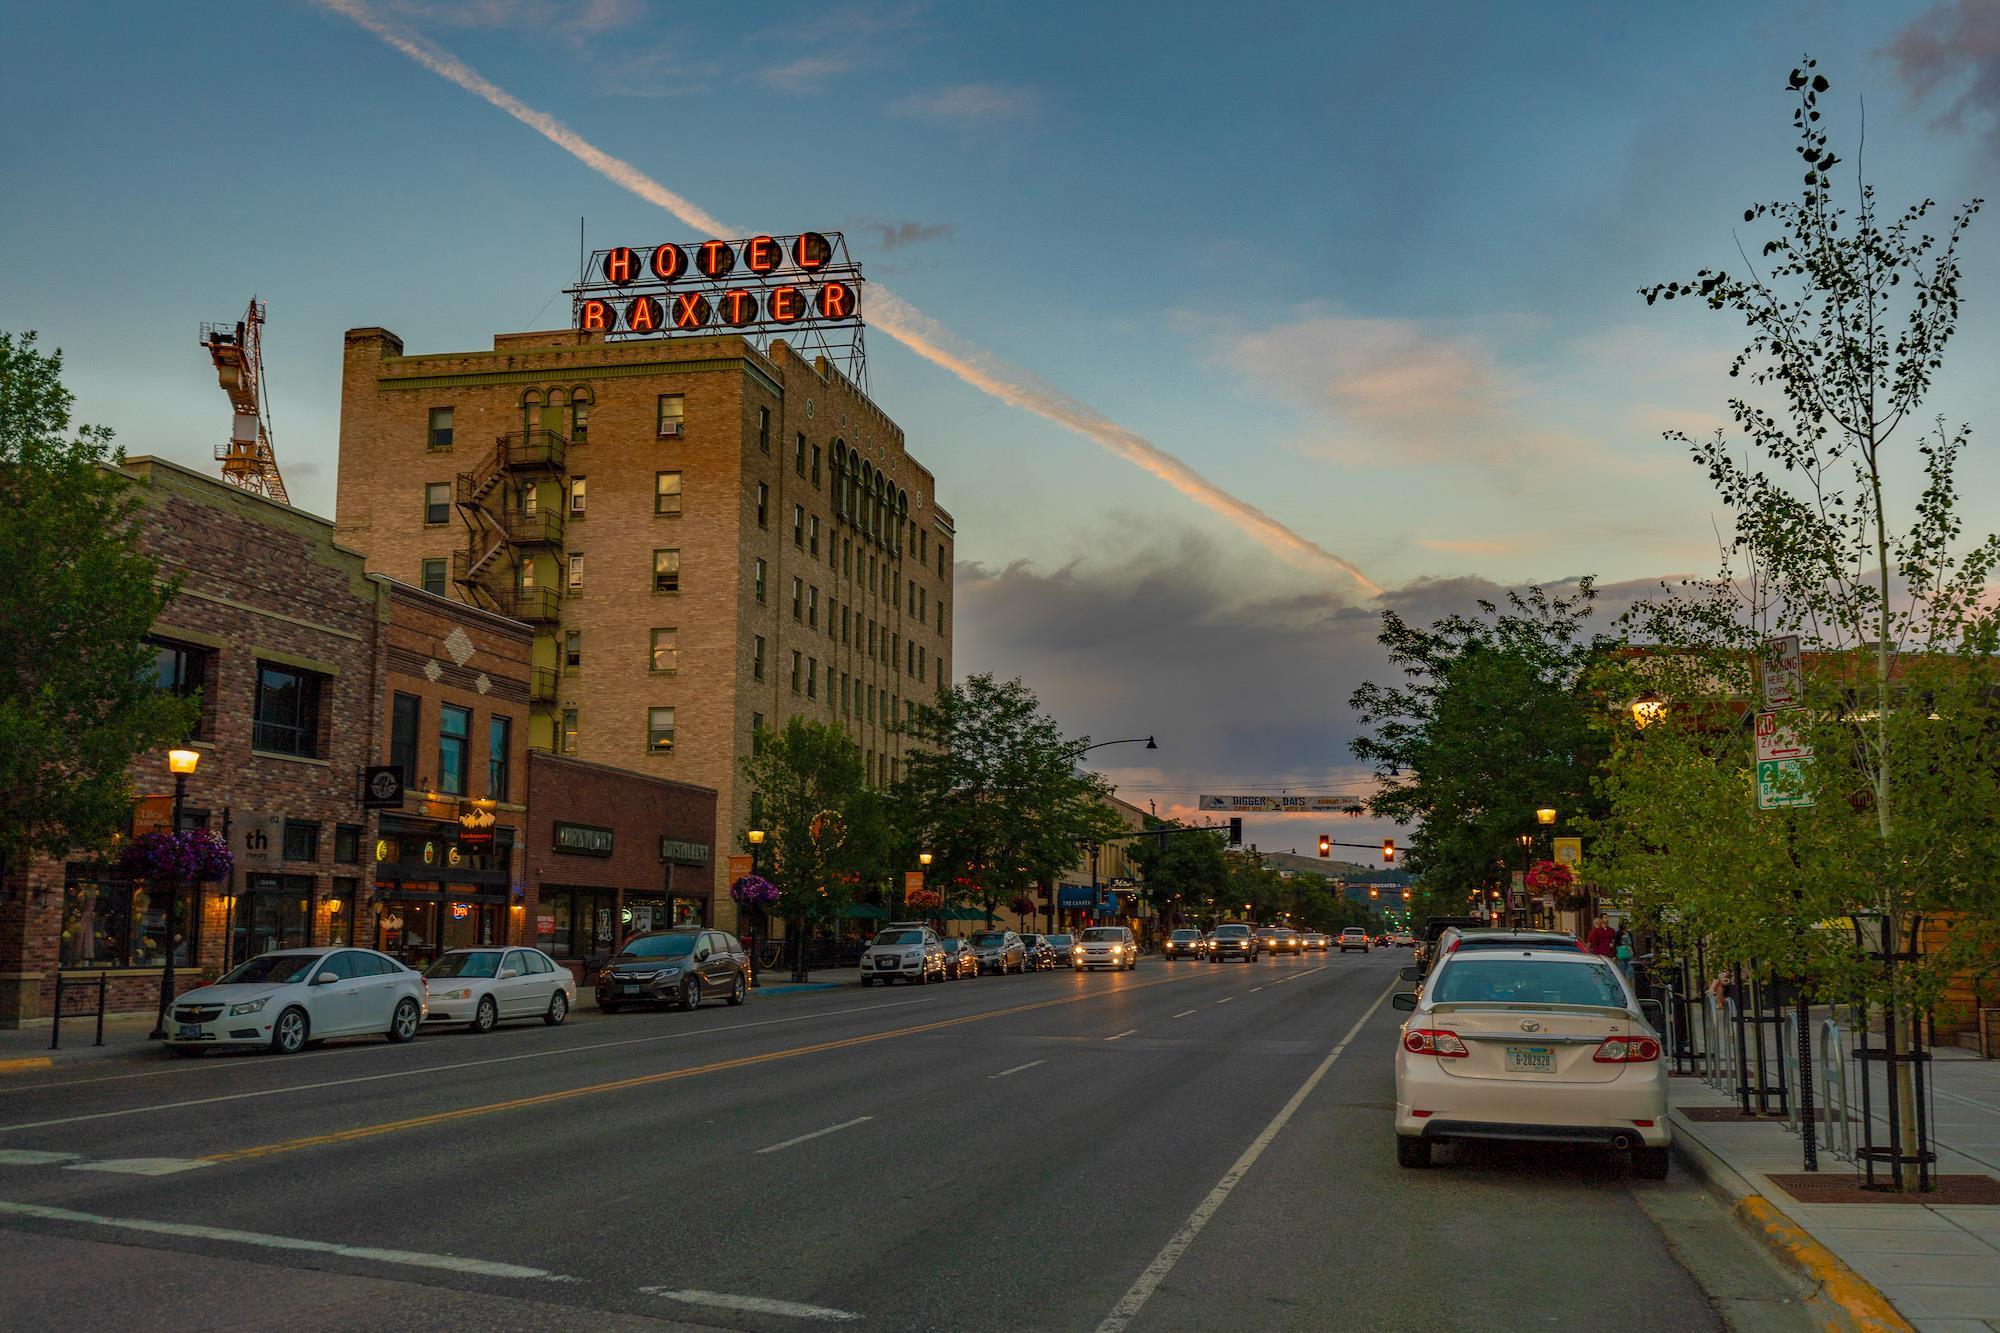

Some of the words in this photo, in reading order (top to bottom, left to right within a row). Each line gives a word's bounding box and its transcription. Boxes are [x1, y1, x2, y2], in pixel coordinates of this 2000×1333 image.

[609, 235, 820, 281] HOTEL
[1772, 641, 1787, 656] NO
[1765, 656, 1797, 674] PARKING
[1758, 715, 1774, 735] NO
[1763, 763, 1773, 781] 2
[1232, 797, 1266, 806] DIGGER
[1282, 797, 1305, 806] DAYS
[246, 829, 268, 849] th
